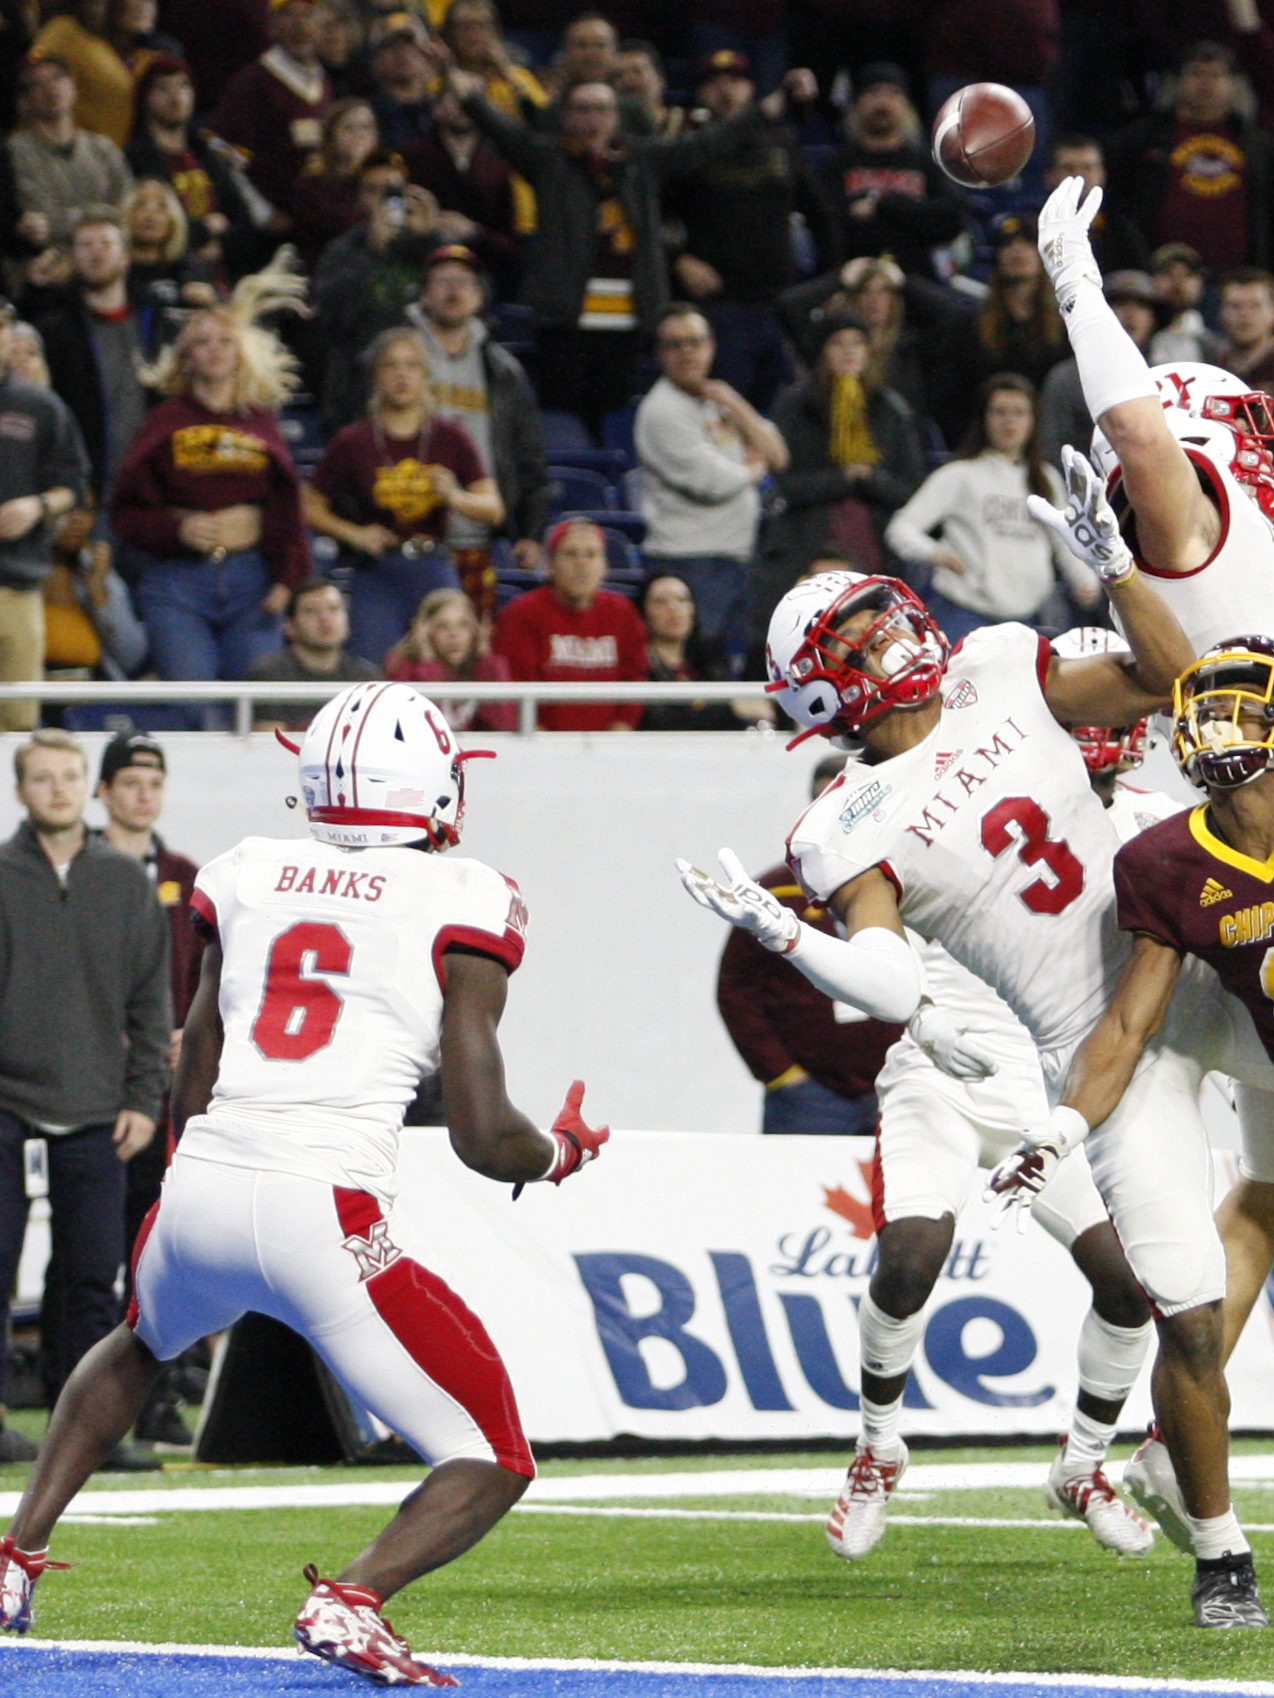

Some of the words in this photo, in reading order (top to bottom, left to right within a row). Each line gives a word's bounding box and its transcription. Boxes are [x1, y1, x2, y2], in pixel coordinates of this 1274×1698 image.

[424, 709, 451, 755] 6
[905, 717, 1028, 848] MIAMI
[934, 749, 964, 781] adidas
[327, 832, 369, 843] MIAMI
[978, 793, 1084, 916] 3
[274, 866, 387, 901] BANKS
[1200, 889, 1233, 907] adidas
[249, 919, 354, 1064] 6
[770, 1226, 990, 1280] Latt
[572, 1249, 1056, 1412] Blue
